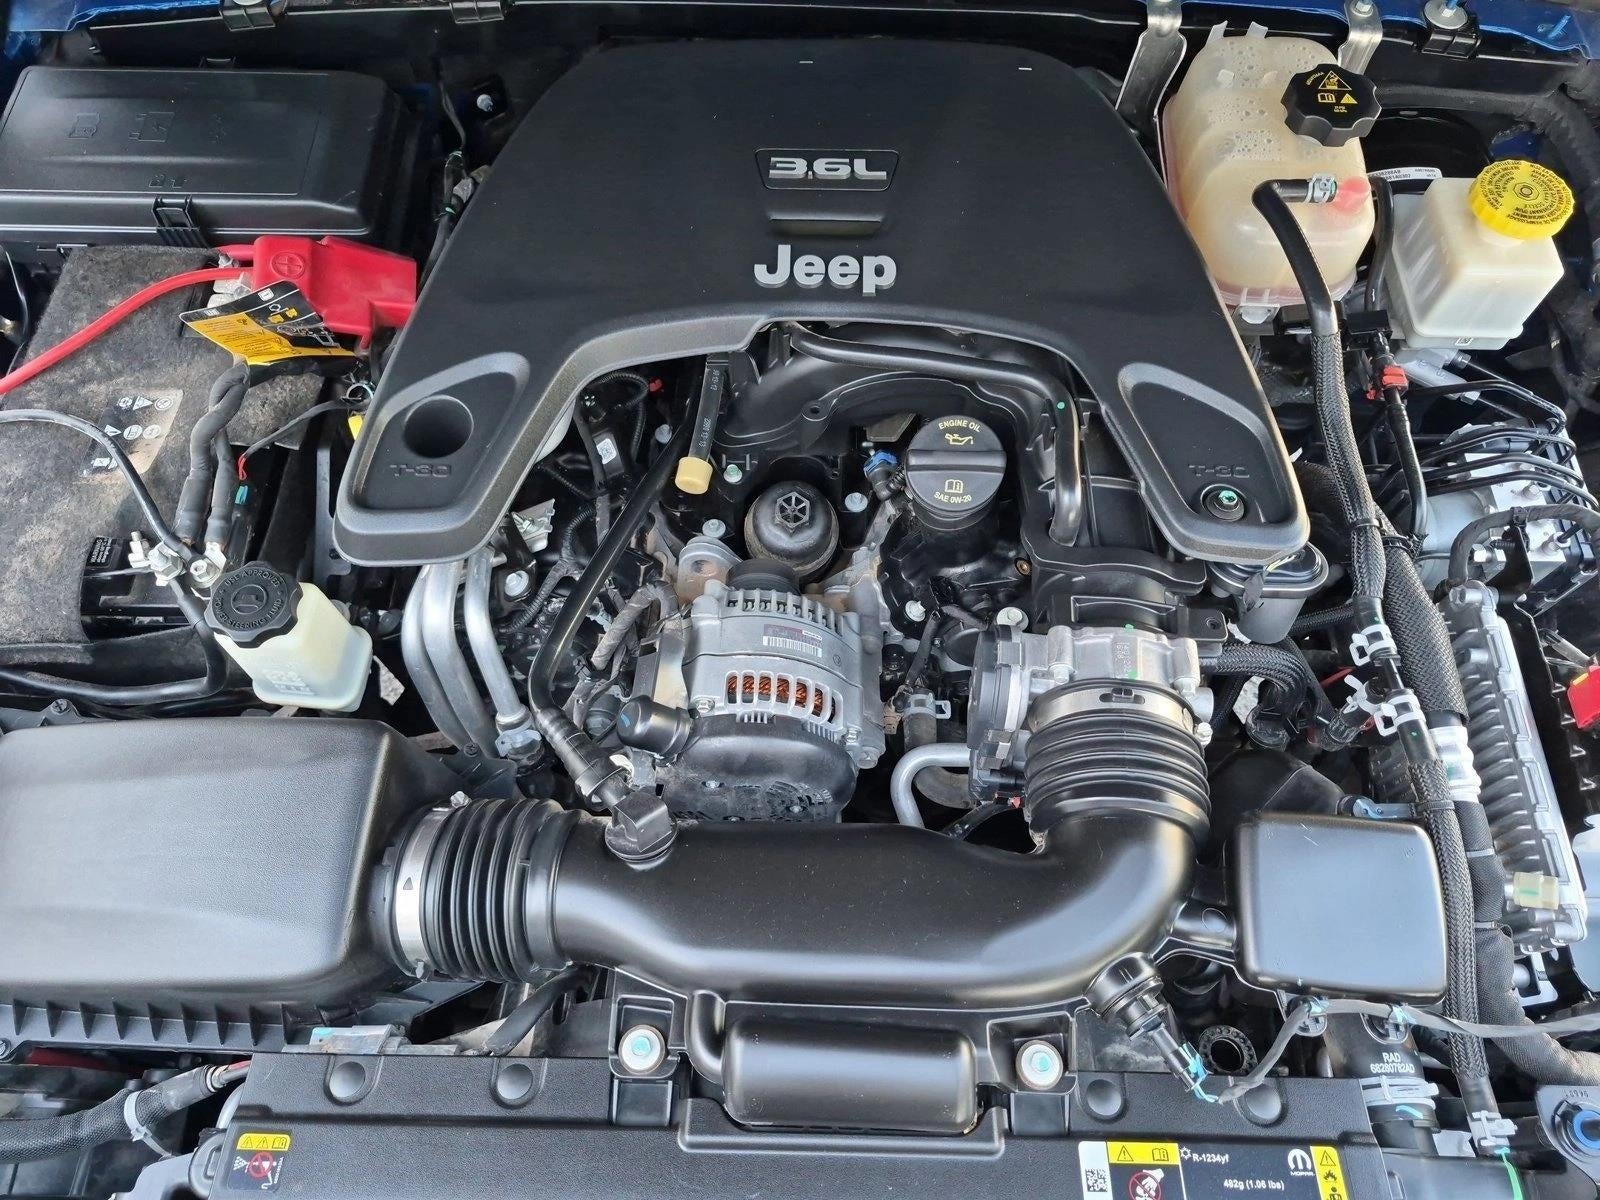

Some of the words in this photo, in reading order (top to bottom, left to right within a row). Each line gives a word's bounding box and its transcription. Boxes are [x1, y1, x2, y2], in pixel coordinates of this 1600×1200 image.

[769, 157, 887, 180] 3.6L
[754, 244, 897, 296] Jeep
[938, 419, 969, 430] ENGINE
[968, 422, 982, 433] OIL
[934, 491, 949, 503] SAE
[224, 574, 240, 586] USE
[241, 569, 280, 587] APPROVED
[1192, 1153, 1229, 1164] R-1234yf
